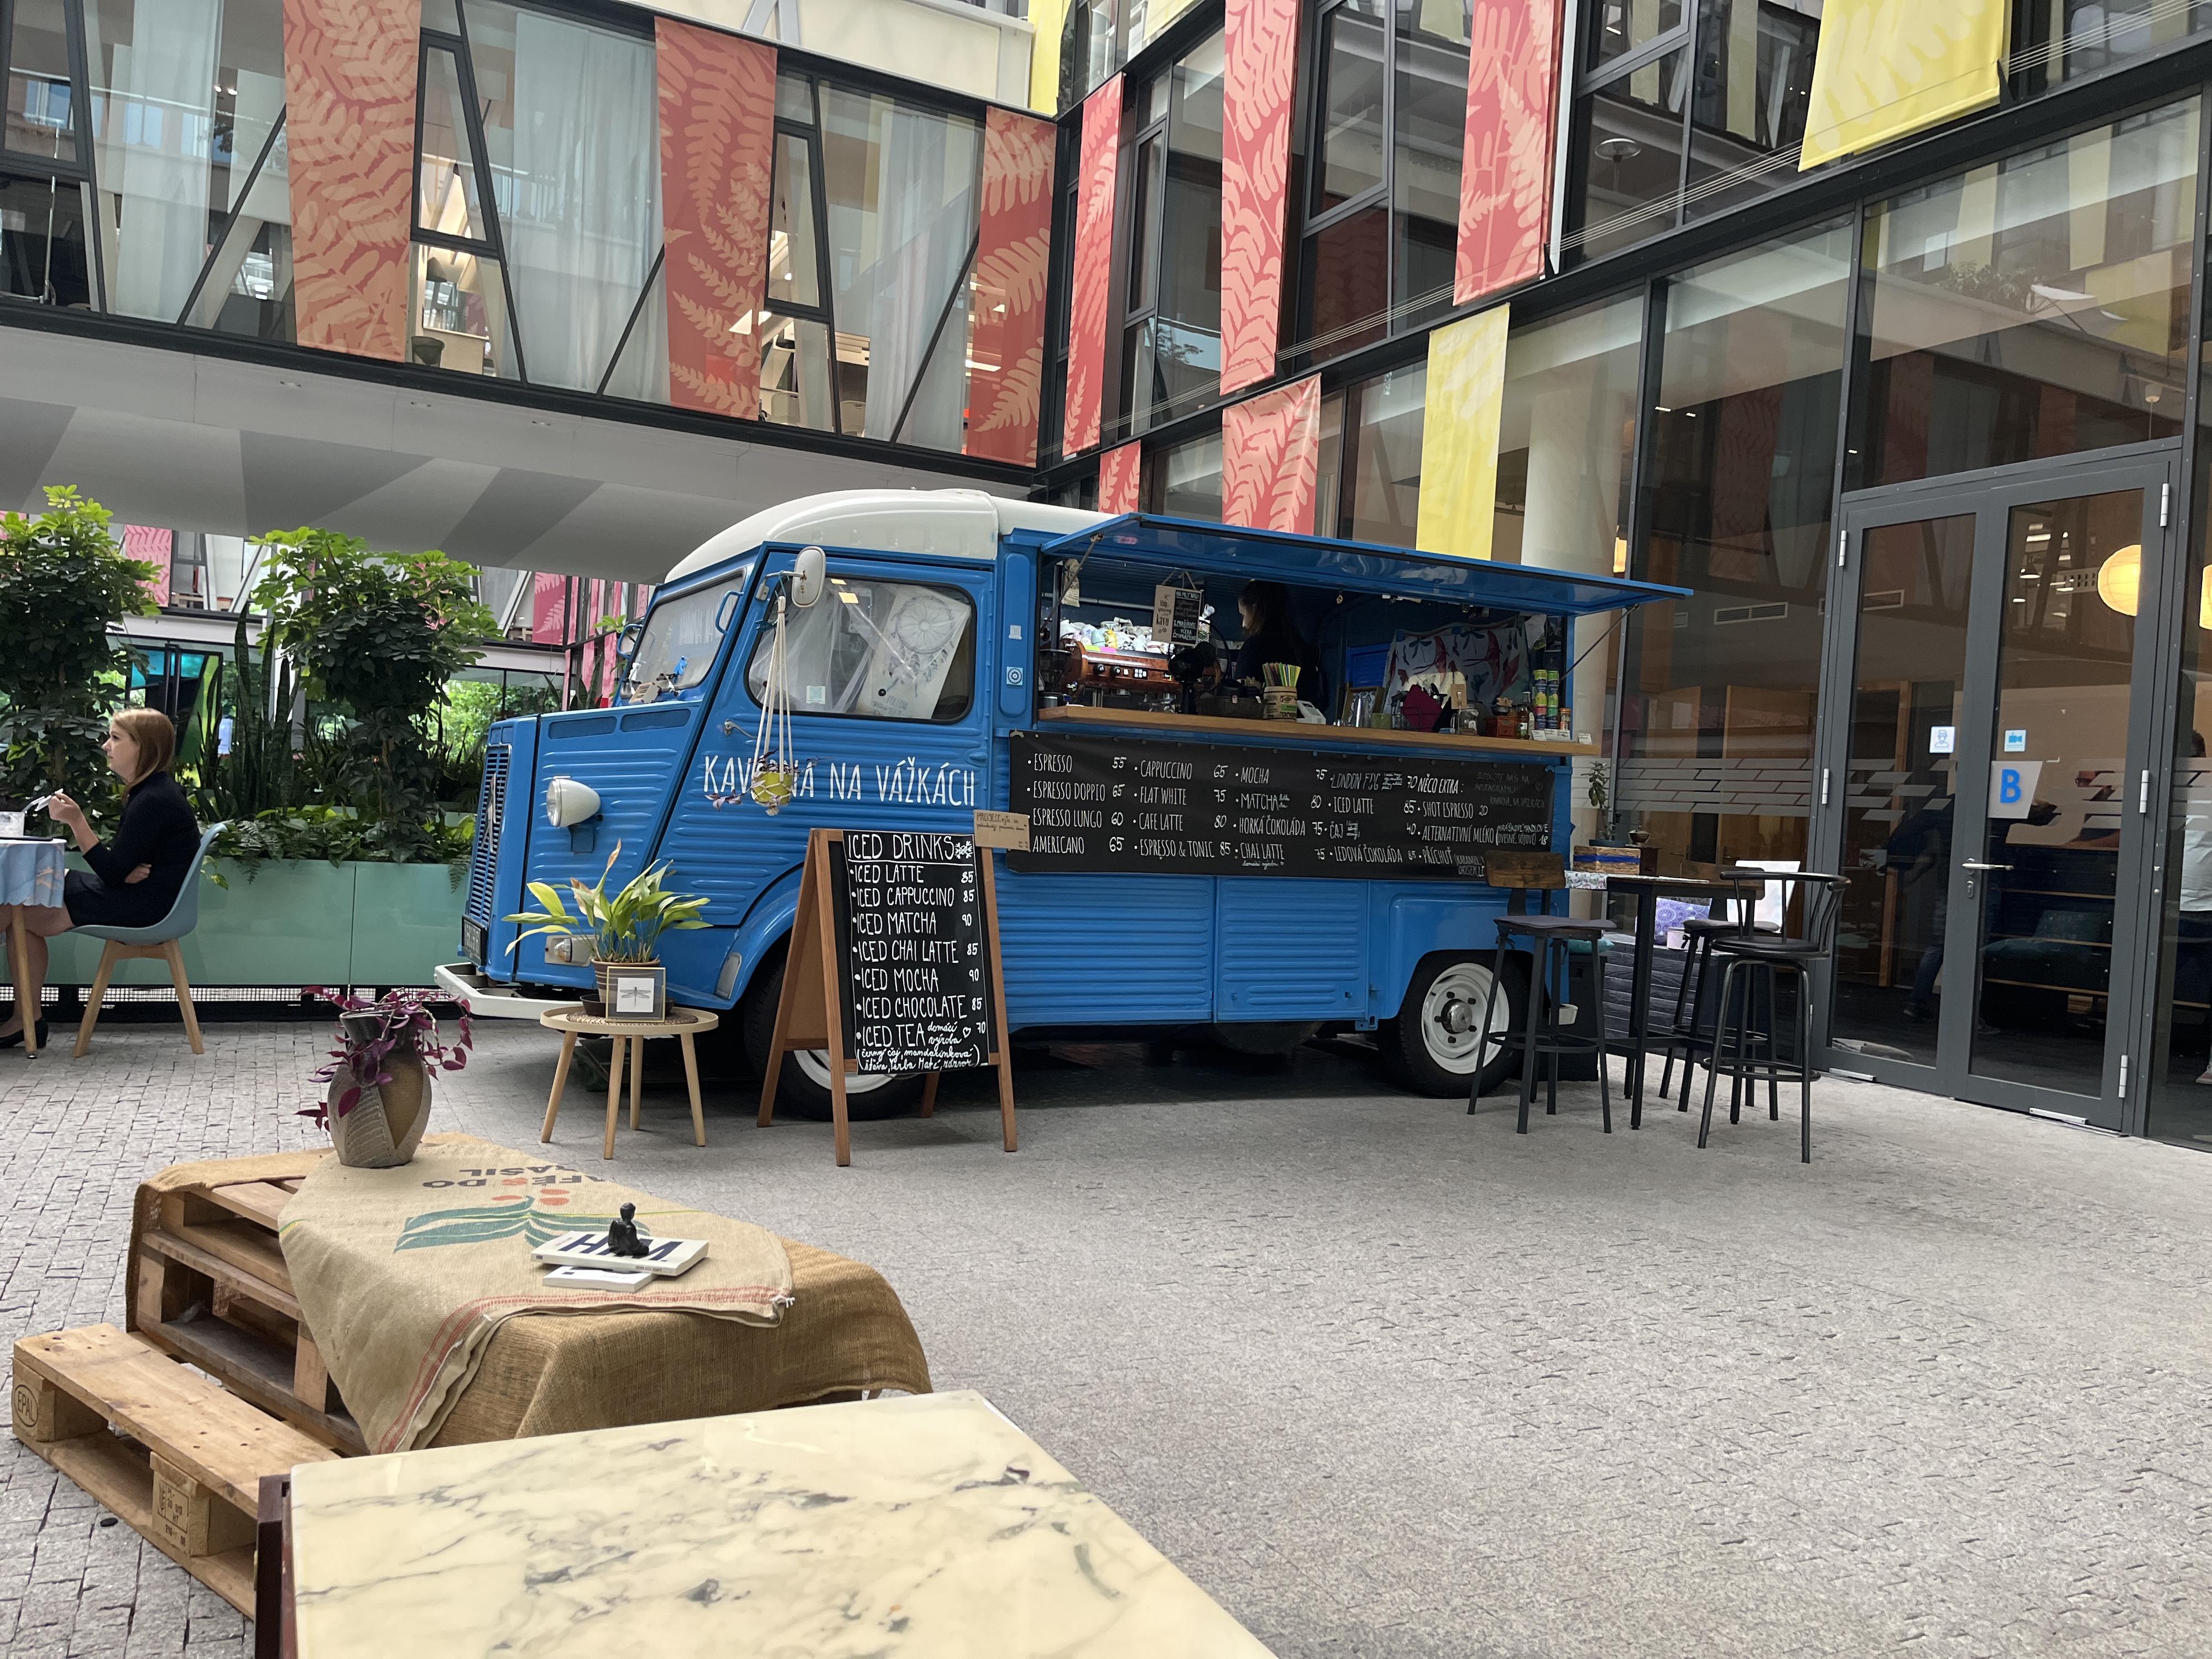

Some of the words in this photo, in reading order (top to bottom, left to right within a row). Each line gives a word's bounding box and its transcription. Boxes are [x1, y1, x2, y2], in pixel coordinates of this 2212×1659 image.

[1034, 753, 1072, 773] ESPRESSO
[1112, 757, 1127, 769] 55
[1140, 760, 1192, 780] CAPPUCCINO
[1213, 765, 1228, 778] 65
[830, 762, 861, 800] NA
[876, 757, 975, 806] VÁŽKÁCH
[1240, 767, 1269, 784] MOCHA
[1316, 769, 1327, 780] 75
[1331, 773, 1362, 790] LONDON
[1407, 775, 1418, 789] 70
[1417, 773, 1438, 794] NĚCO
[1034, 781, 1071, 800] ESPRESSO
[1074, 782, 1105, 801] DOPPIO
[1113, 784, 1125, 797] 65
[1140, 786, 1159, 804] FLAT
[1161, 787, 1187, 805] WHITE
[1213, 789, 1227, 802] 75
[2000, 769, 2021, 803] B
[1241, 793, 1279, 811] MATCHA
[1311, 795, 1322, 808] 80
[1333, 797, 1350, 813] ICED
[1353, 797, 1374, 814] LATTE
[1404, 800, 1417, 813] 85
[1423, 801, 1441, 817] SHOT
[1443, 802, 1474, 818] ESPRESSO
[1479, 805, 1488, 816] 20
[1033, 807, 1071, 827] ESPRESSO
[1074, 810, 1102, 828] LUNGO
[1111, 812, 1123, 826] 60
[1139, 812, 1158, 830] CAFE
[1160, 813, 1183, 831] LATTE
[1214, 815, 1227, 828] 80
[1239, 815, 1265, 834] HORKÁ
[1266, 815, 1306, 836] ČOKOLÁDA
[1312, 821, 1323, 836] 75
[1329, 821, 1343, 839] ČAJ
[1406, 822, 1416, 835] 40
[1422, 825, 1473, 842] ALTERNATIVNÍ
[1473, 825, 1494, 843] MLÉKO
[848, 835, 883, 860] ICED
[893, 835, 954, 860] DRINKS
[1032, 836, 1084, 854] AMERICANO
[1109, 836, 1124, 852] 65
[1140, 839, 1176, 857] ESPRESSO
[1178, 841, 1186, 857] &
[1187, 841, 1215, 858] TONIC
[1219, 841, 1231, 856] 85
[1240, 842, 1260, 859] CHAI
[1261, 843, 1284, 860] LATTE
[1314, 848, 1325, 860] 75
[1334, 844, 1363, 862] LEDOVÁ
[1363, 844, 1403, 863] ČOKOLÁDA
[855, 865, 881, 883] ICED
[886, 864, 924, 883] LATTE
[961, 871, 974, 883] 85
[857, 888, 880, 906] ICED
[887, 887, 954, 907] CAPPUCCINO
[963, 889, 974, 902] 85
[857, 913, 883, 935] ICED
[888, 912, 936, 935] MATCHA
[962, 914, 972, 927] 90
[859, 941, 887, 962] ICED
[891, 940, 919, 962] CHAI
[922, 941, 959, 963] LATTE
[967, 943, 978, 956] 85
[862, 969, 888, 991] ICED
[894, 969, 939, 993] MOCHA
[969, 969, 979, 982] 90
[863, 997, 891, 1019] ICED
[895, 995, 967, 1019] CHOCOLATE
[972, 997, 983, 1010] 85
[863, 1026, 892, 1047] ICED
[895, 1023, 925, 1047] TEA
[976, 1021, 985, 1034] 70
[459, 1165, 578, 1176] ASIL
[422, 1178, 487, 1188] DO
[18, 1391, 35, 1422] EPAL
